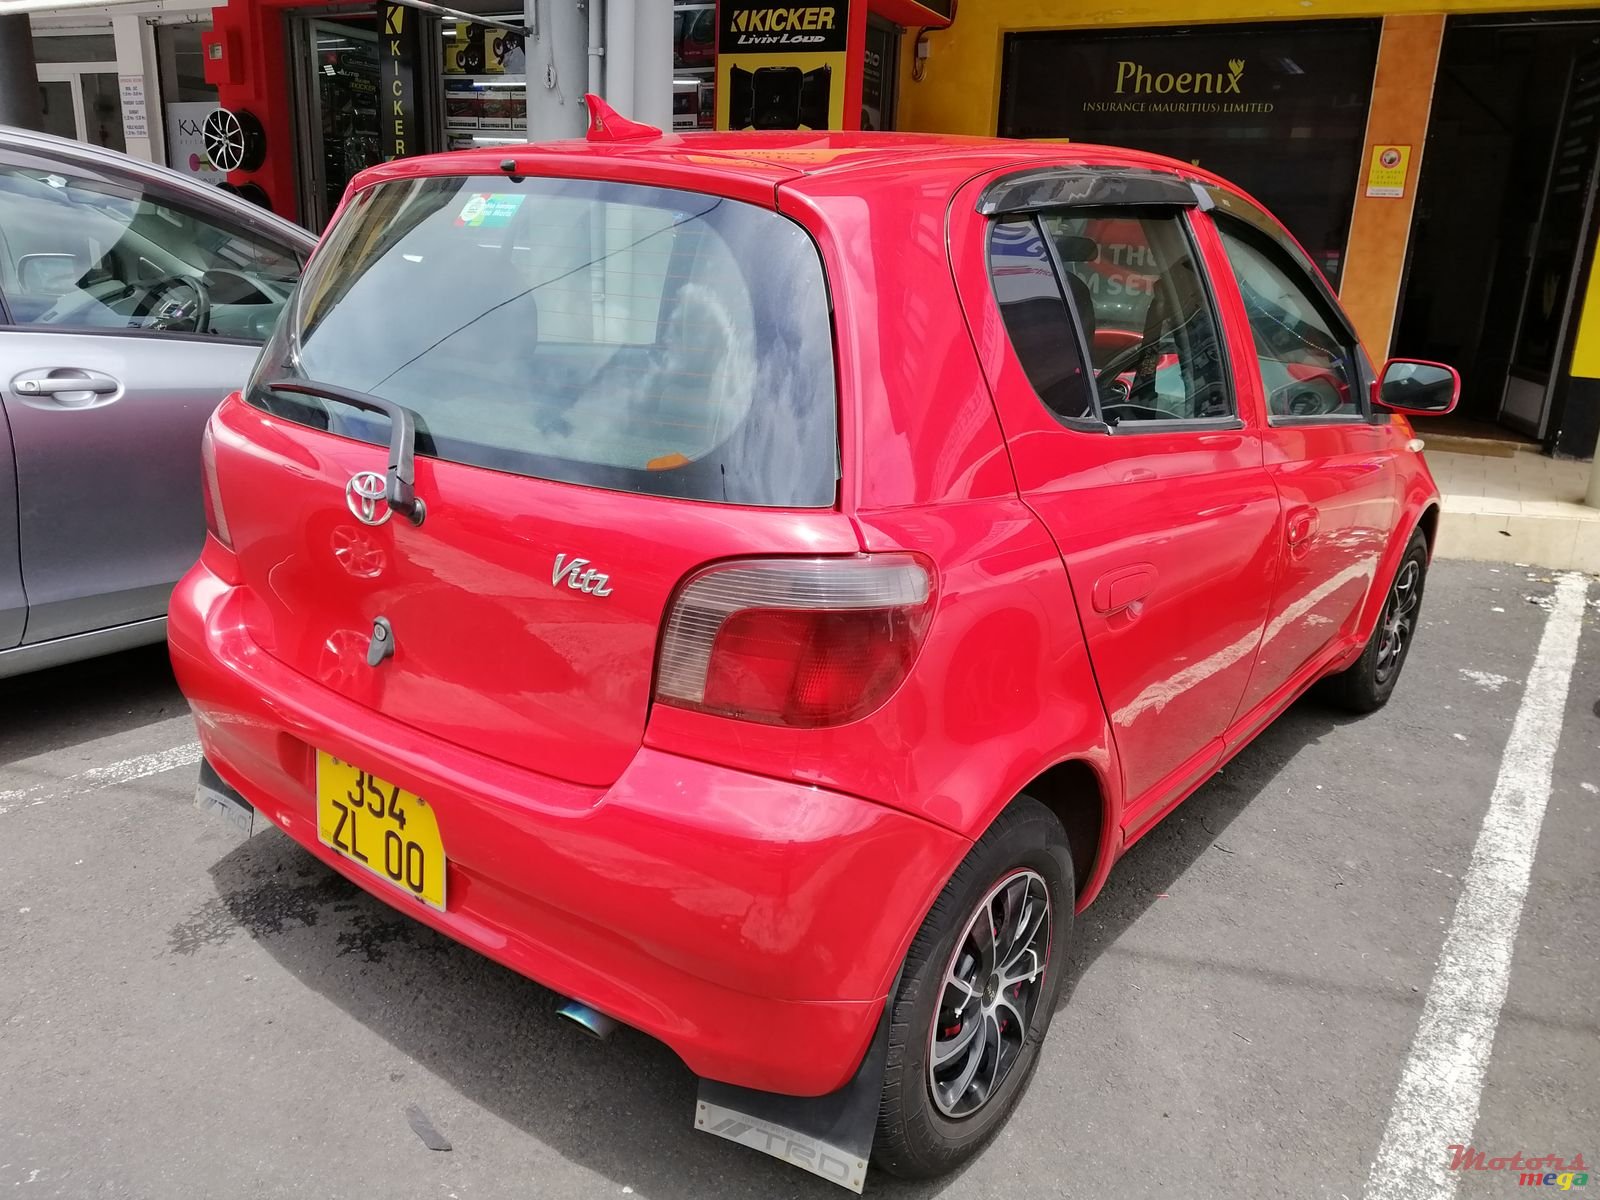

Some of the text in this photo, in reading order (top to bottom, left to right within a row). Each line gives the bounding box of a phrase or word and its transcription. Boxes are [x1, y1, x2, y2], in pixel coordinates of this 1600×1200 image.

[748, 7, 834, 31] KICKER
[1114, 58, 1246, 94] Phoenix
[391, 40, 405, 155] KICKER
[1082, 102, 1274, 113] INSURANCE (MAURITIUS) LIMITED
[178, 119, 205, 136] KA
[1107, 273, 1161, 296] SET
[552, 553, 614, 597] Vitz
[346, 764, 407, 831] 354
[332, 799, 369, 864] ZL
[756, 1127, 850, 1182] TRD
